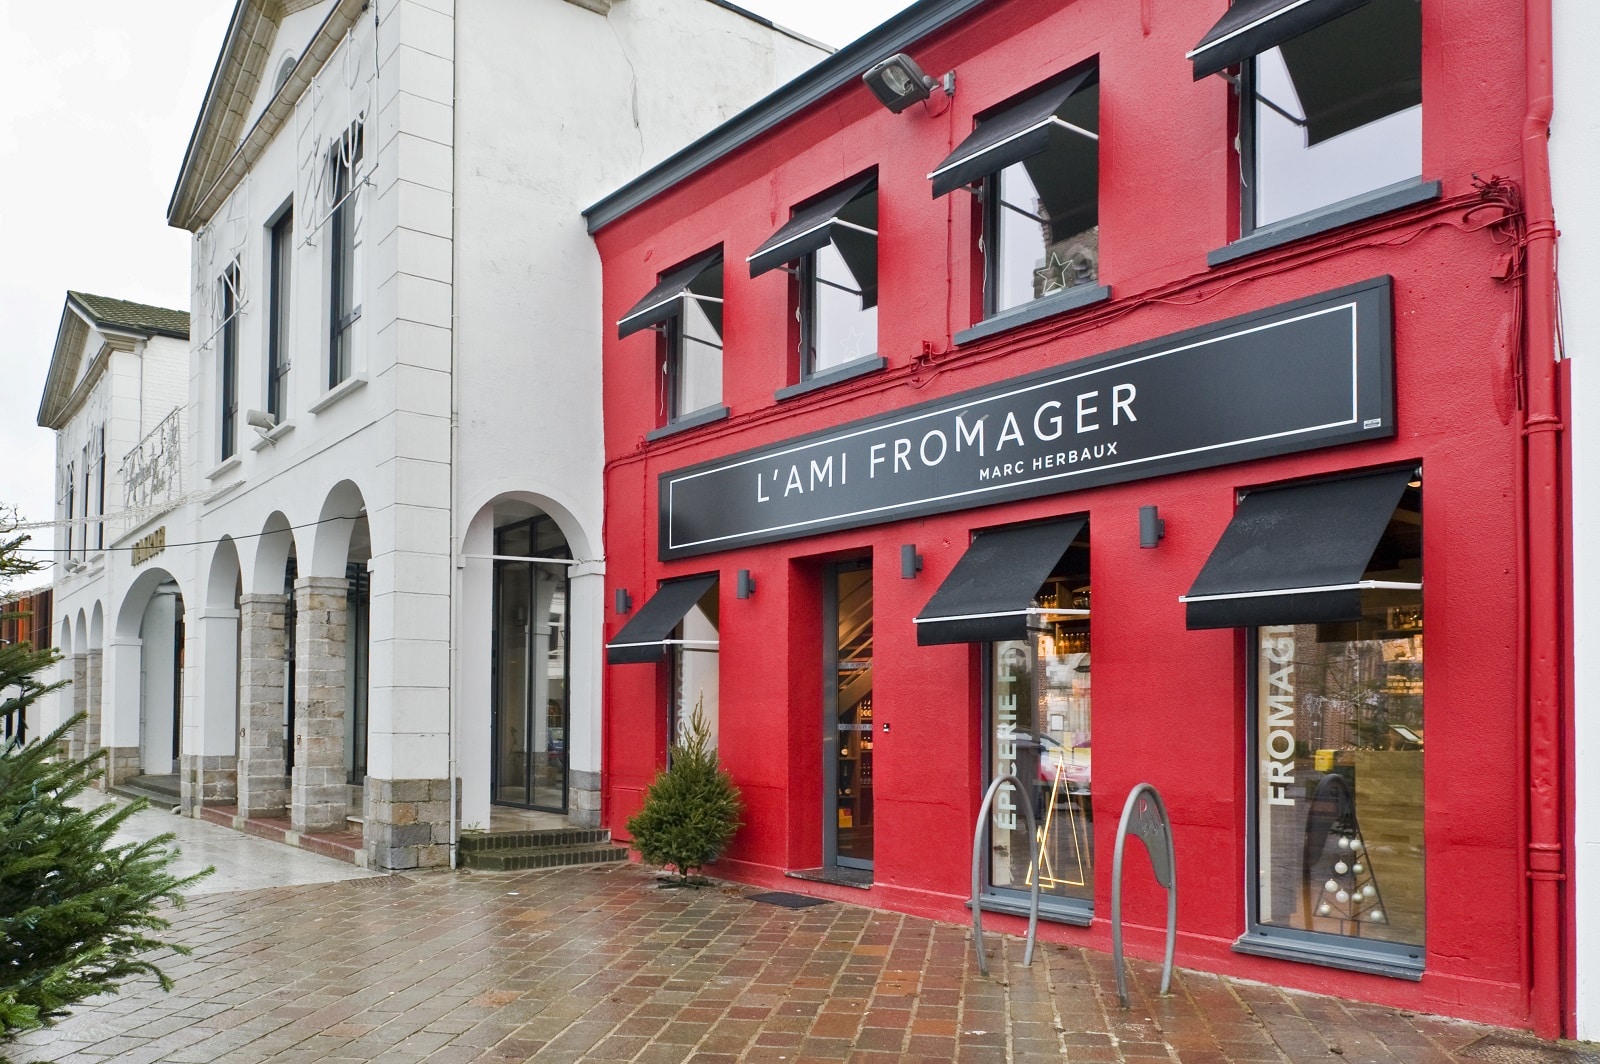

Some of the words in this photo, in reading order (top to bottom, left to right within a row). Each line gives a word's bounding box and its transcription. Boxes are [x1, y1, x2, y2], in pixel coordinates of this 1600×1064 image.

[757, 452, 846, 503] L'AMI
[870, 383, 1137, 479] FROMAGER
[979, 461, 1024, 481] MARC
[1032, 441, 1118, 470] HERBAUX
